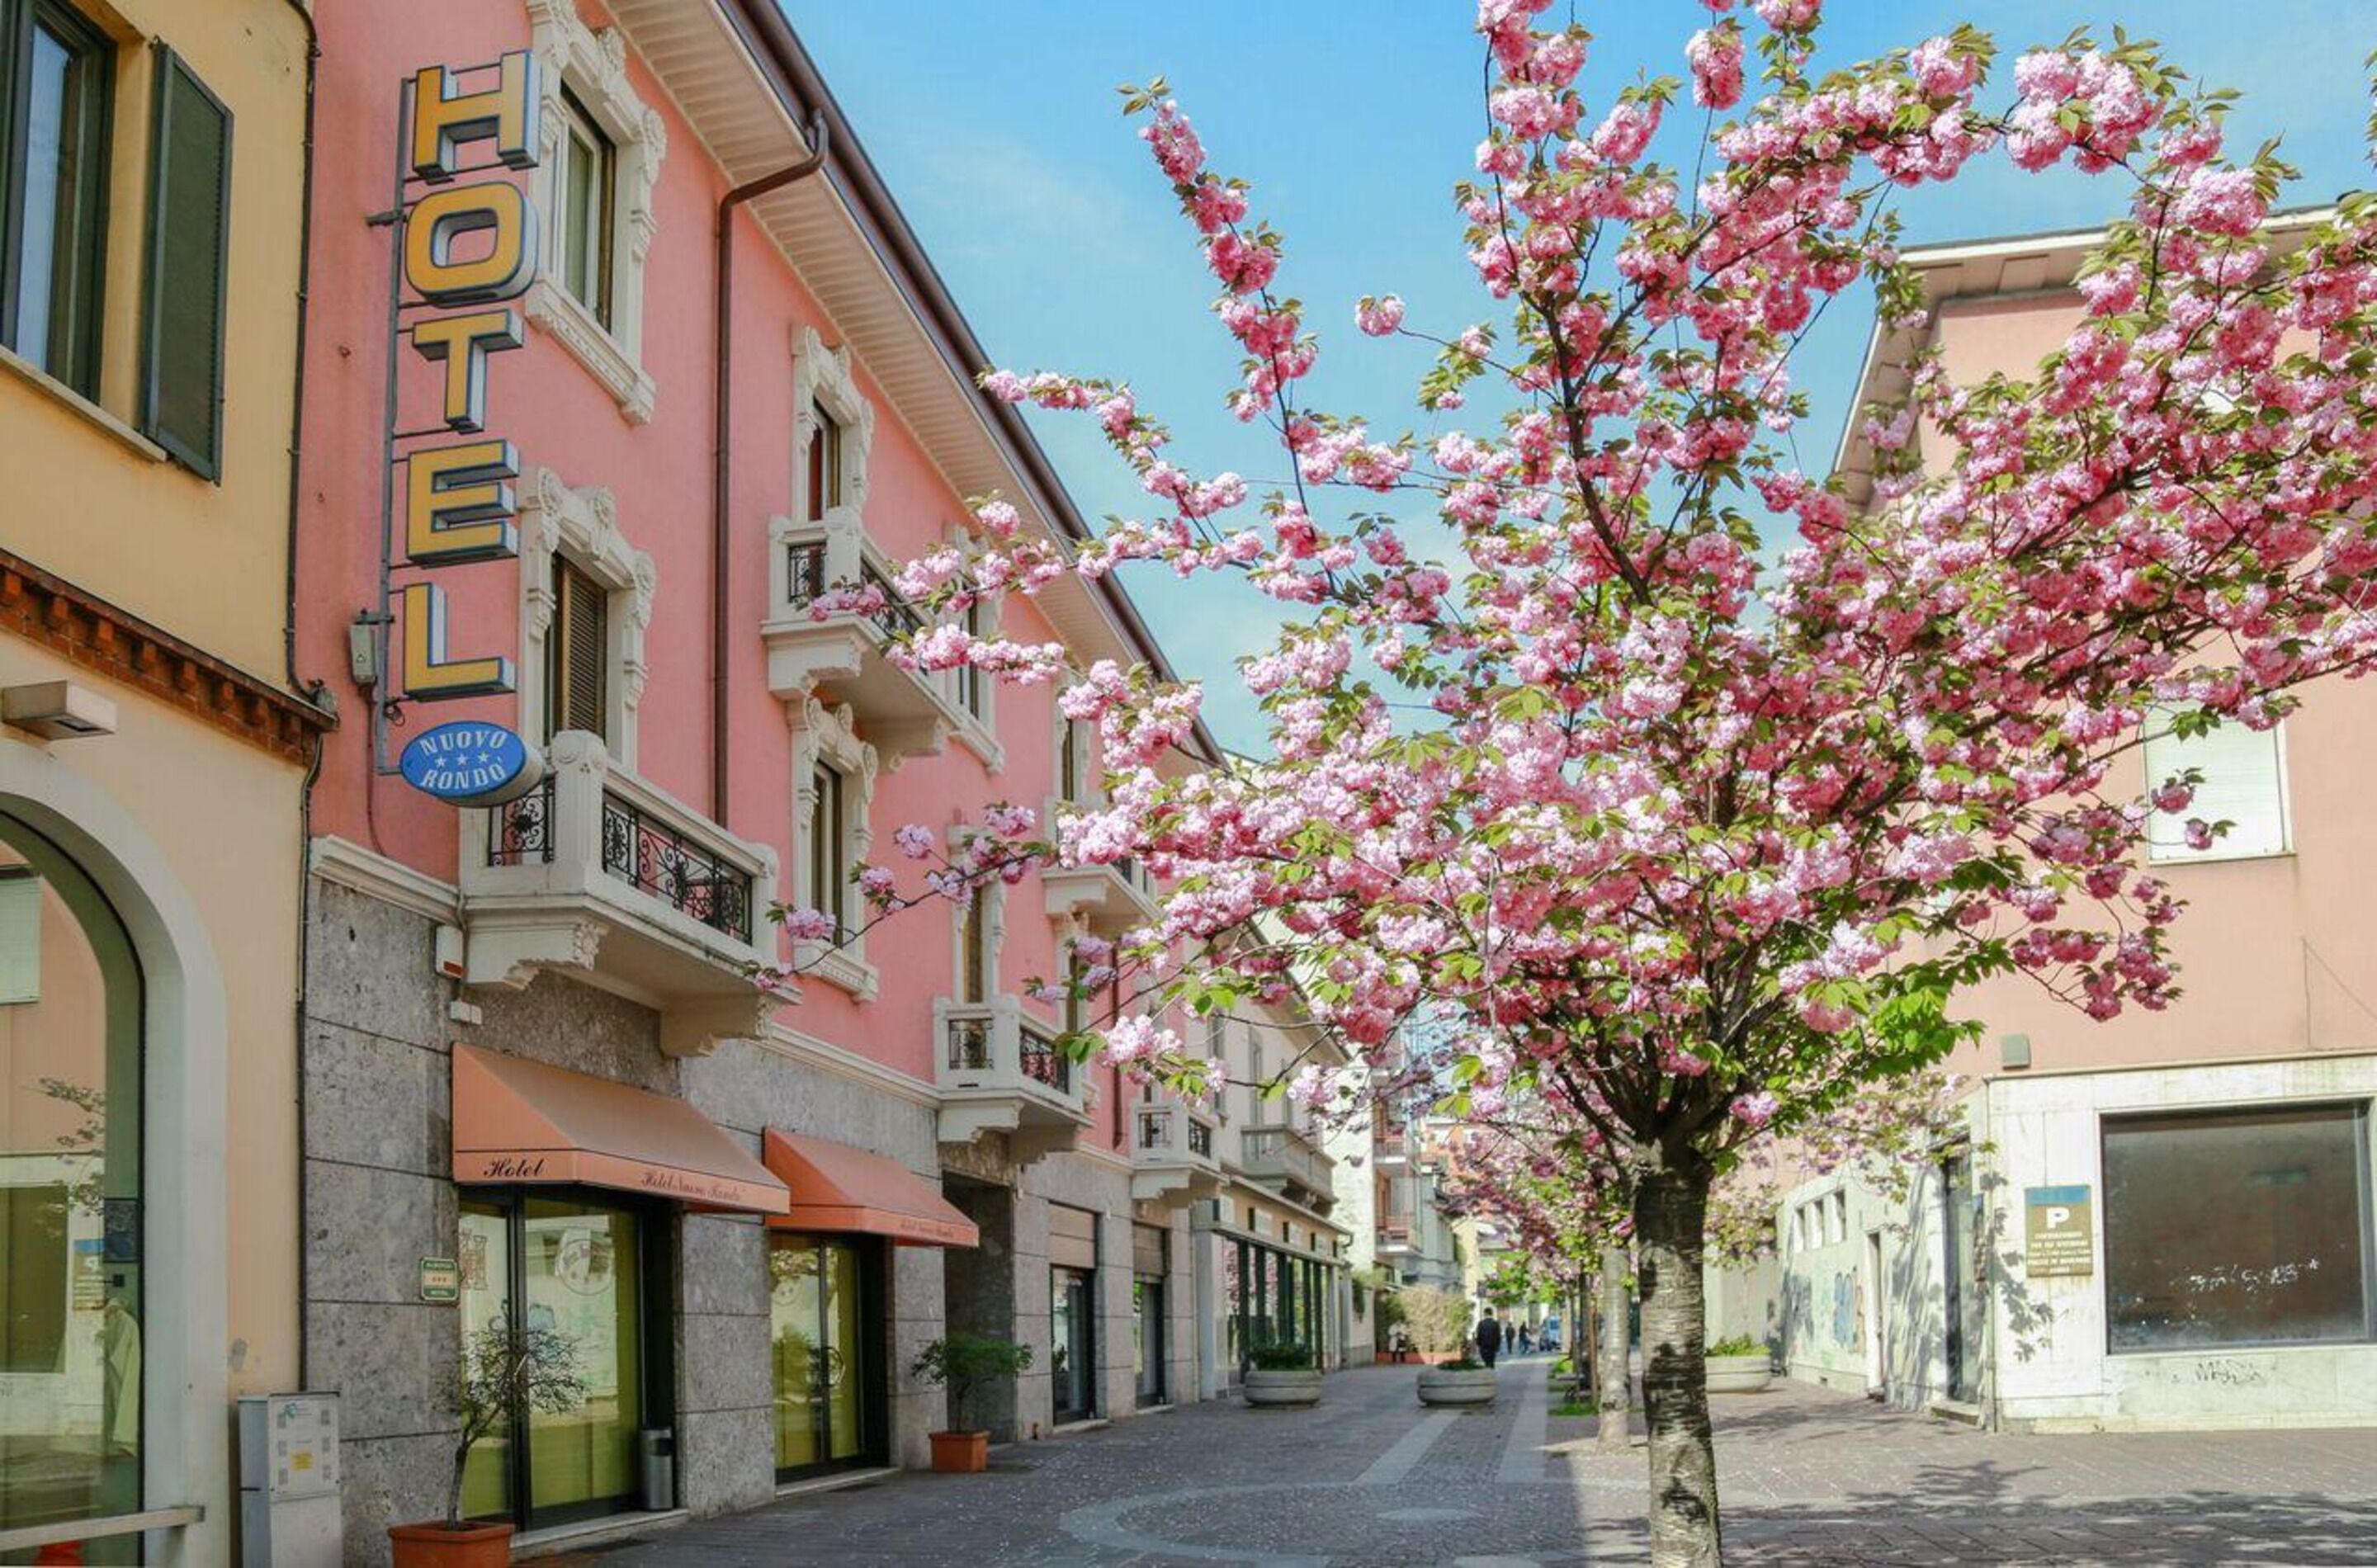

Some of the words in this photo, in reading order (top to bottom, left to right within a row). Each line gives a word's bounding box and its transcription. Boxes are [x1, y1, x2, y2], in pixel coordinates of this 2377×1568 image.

[403, 50, 541, 700] HOTEL
[419, 730, 508, 755] NUOVO
[483, 1159, 546, 1178] Hotel
[2046, 1207, 2069, 1229] P
